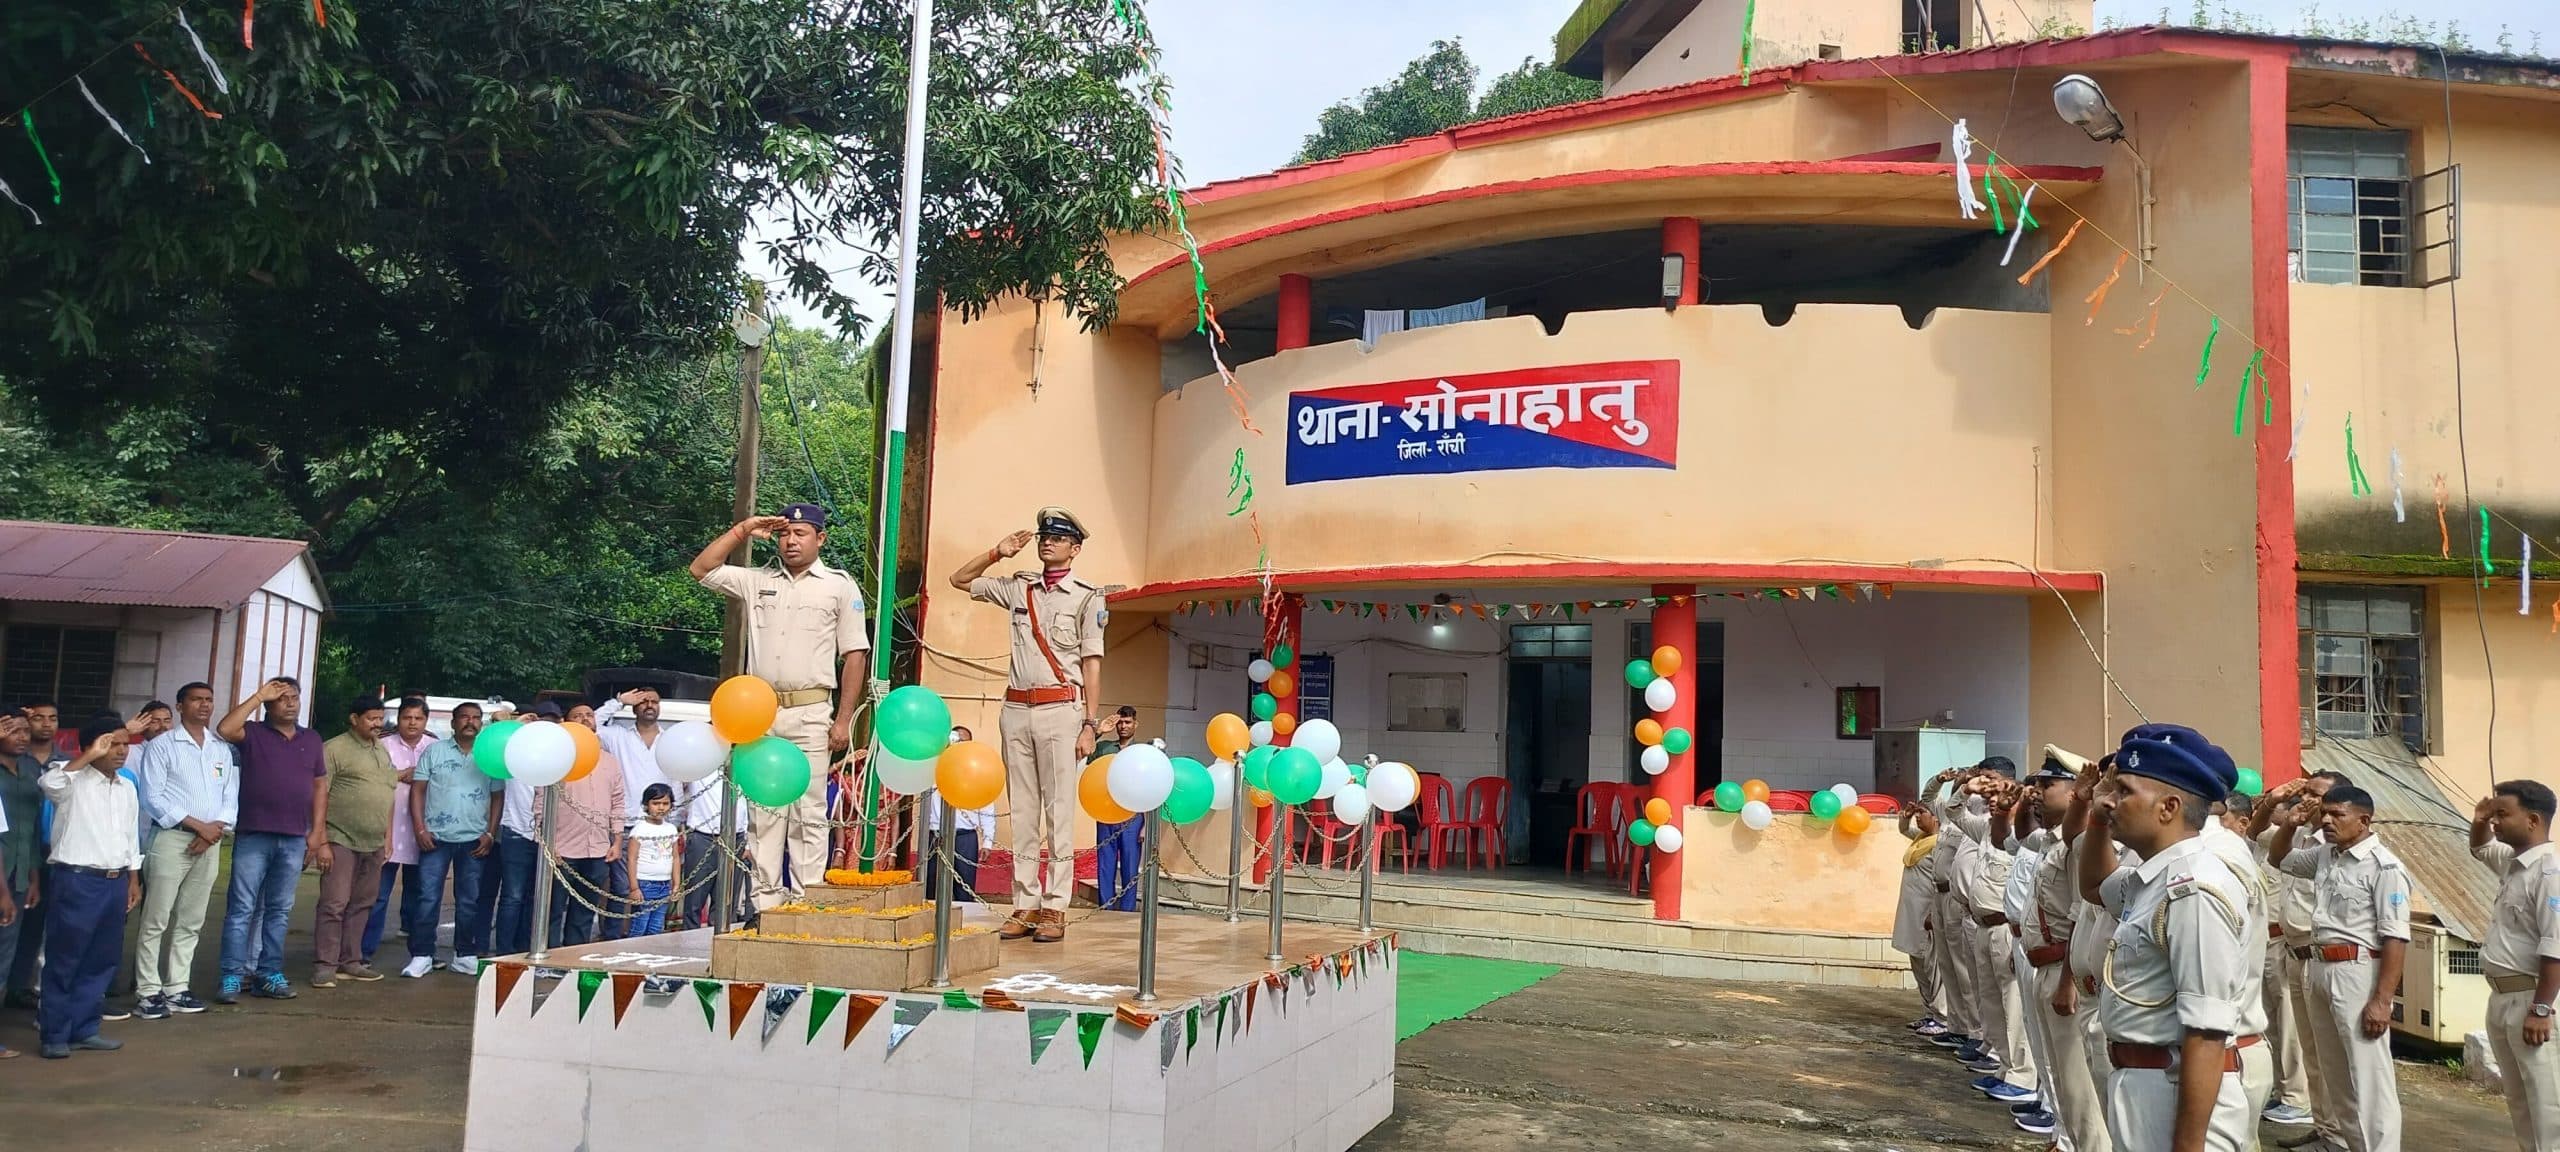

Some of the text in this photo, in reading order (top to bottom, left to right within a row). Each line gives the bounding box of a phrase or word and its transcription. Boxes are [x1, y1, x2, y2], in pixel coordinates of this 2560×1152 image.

[1298, 379, 1650, 446] थाना- सोनाहातु
[1397, 438, 1432, 461] जिला-
